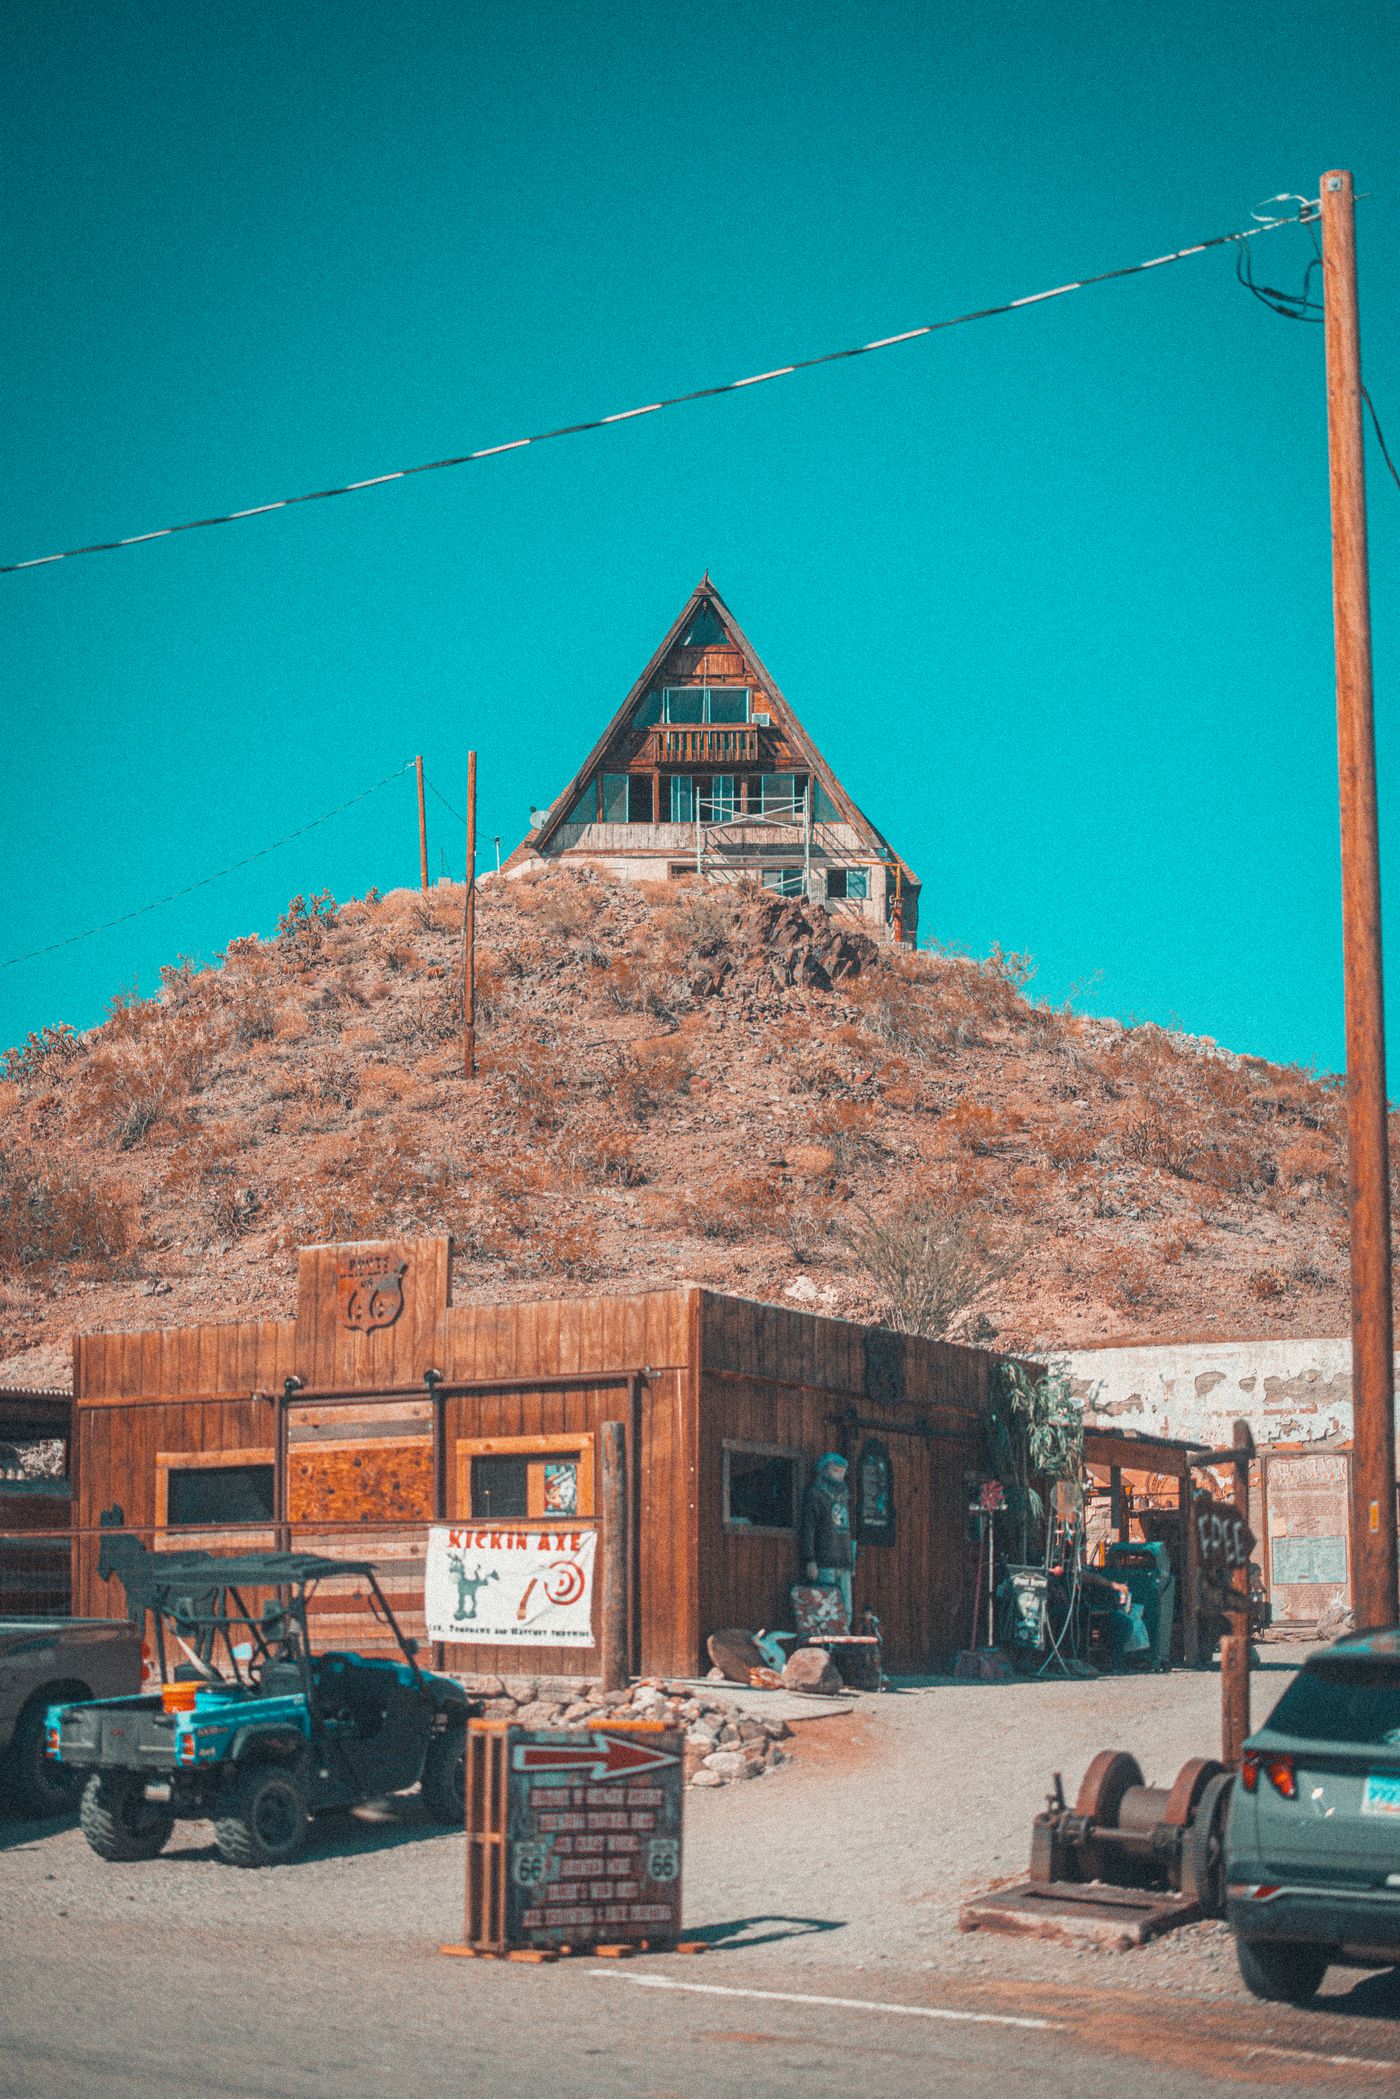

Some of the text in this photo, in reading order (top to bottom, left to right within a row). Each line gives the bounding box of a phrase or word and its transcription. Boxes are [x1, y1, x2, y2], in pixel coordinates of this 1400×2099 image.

[448, 1529, 582, 1551] KICKIN AXE
[519, 1856, 542, 1881] 66
[652, 1854, 674, 1876] 66
